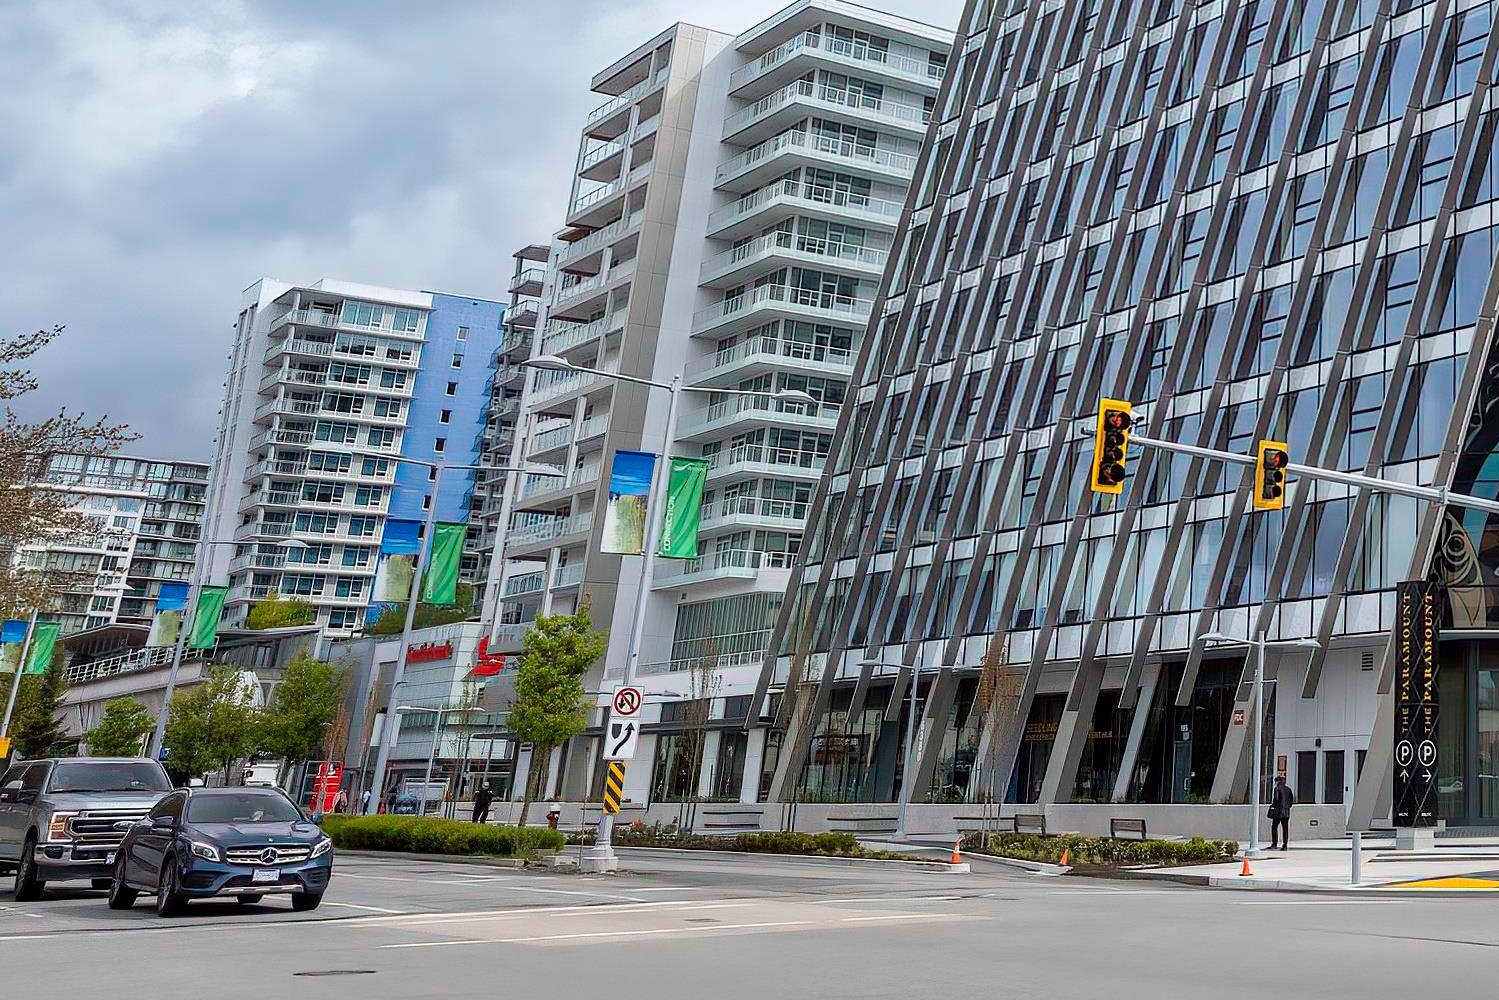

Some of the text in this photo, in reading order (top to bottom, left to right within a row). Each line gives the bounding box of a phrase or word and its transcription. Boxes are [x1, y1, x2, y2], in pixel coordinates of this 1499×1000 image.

[1402, 593, 1411, 700] PARAMOUNT
[1424, 593, 1433, 733] THE PARAMOUNT
